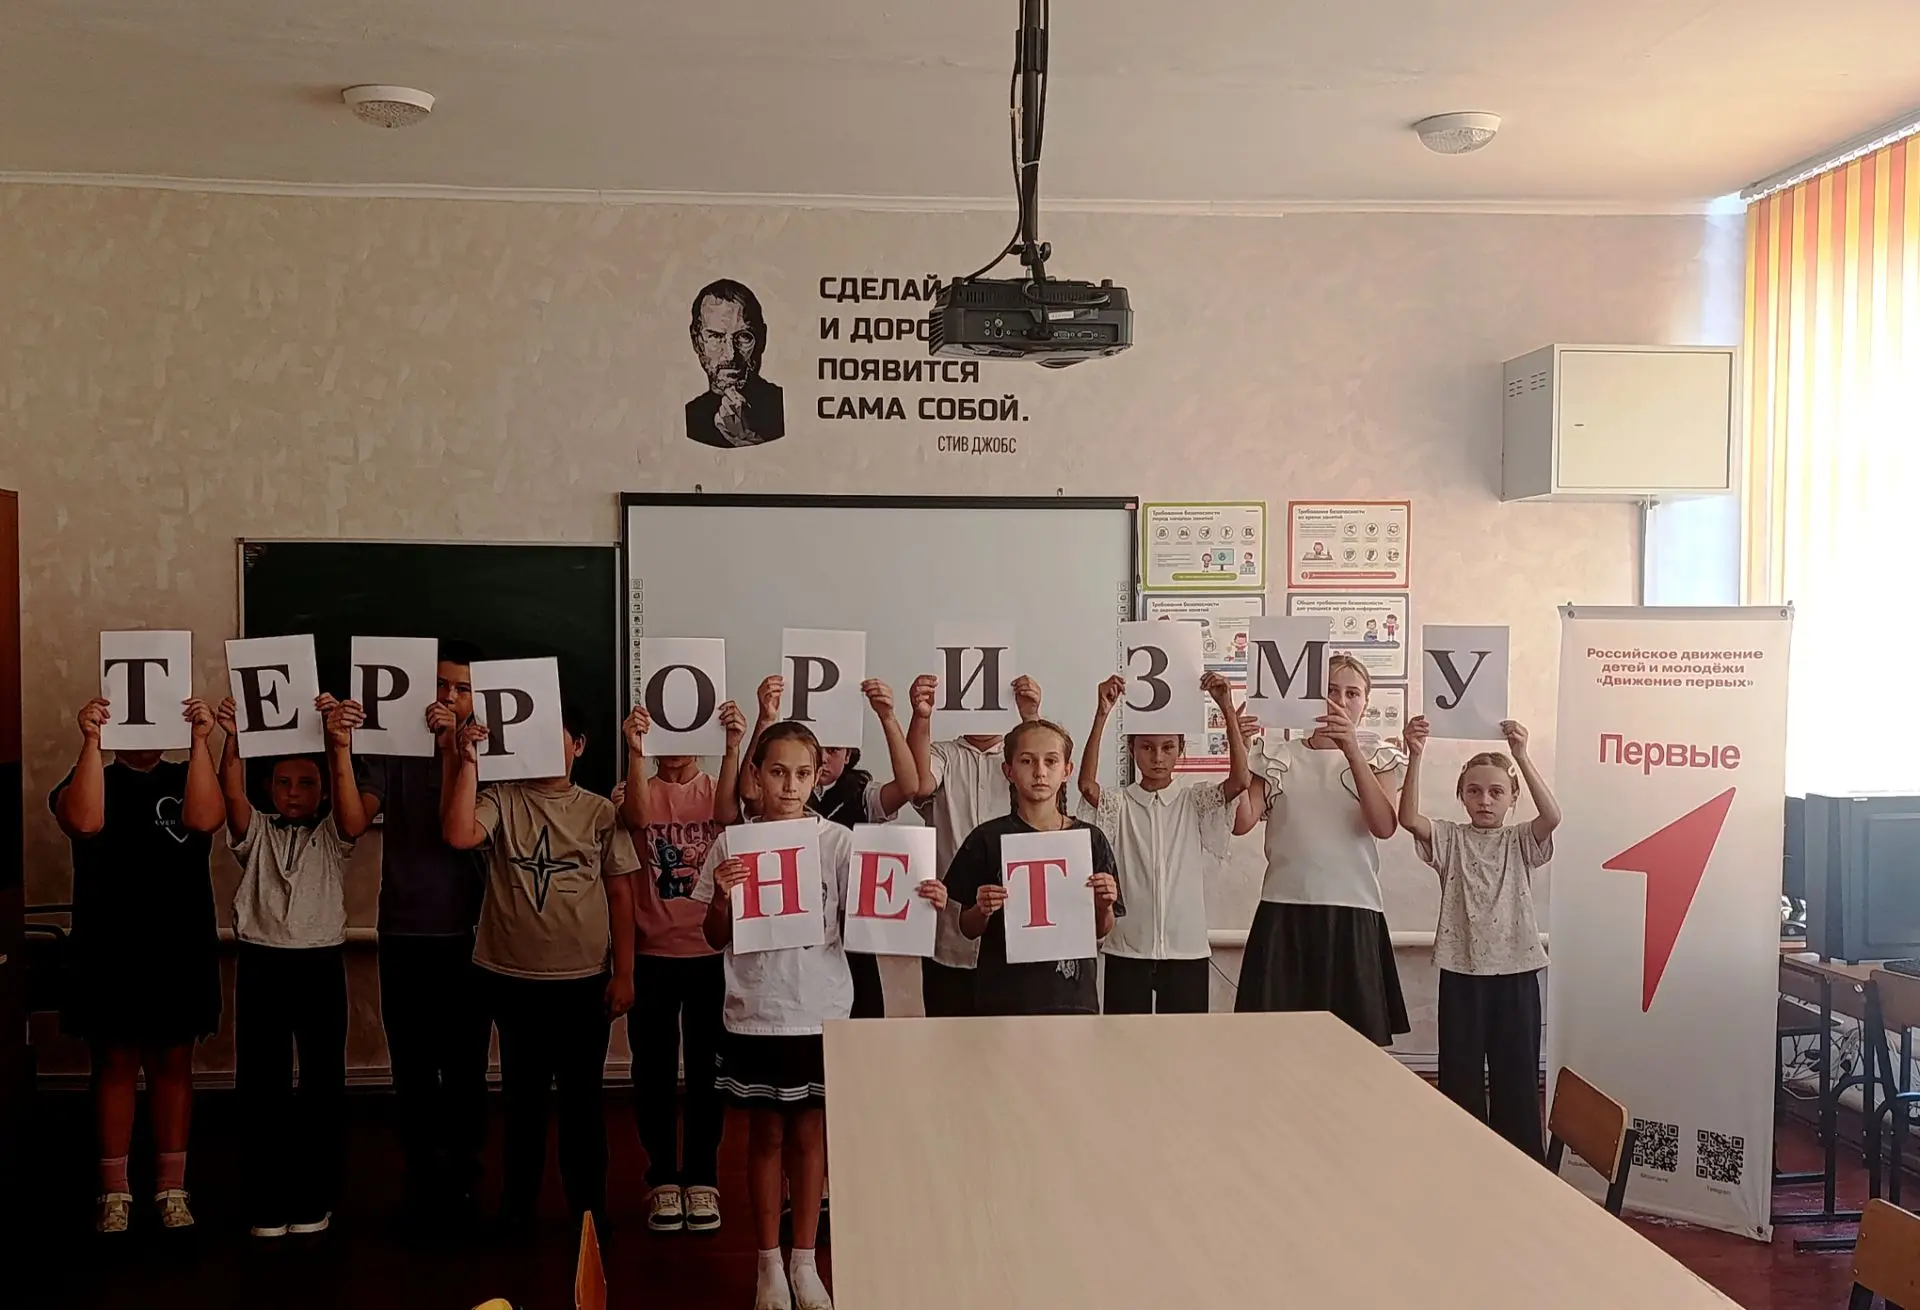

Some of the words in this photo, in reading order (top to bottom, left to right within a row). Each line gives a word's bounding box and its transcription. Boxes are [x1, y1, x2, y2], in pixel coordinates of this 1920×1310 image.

[820, 273, 942, 303] СДЕЛАЙ
[820, 318, 839, 340] И
[850, 318, 930, 343] ДОРО
[818, 358, 980, 383] ПОЯВИТСЯ
[818, 396, 906, 420] САМА
[918, 394, 1029, 421] СОБОЙ.
[937, 435, 969, 452] СТИВ
[971, 436, 1017, 455] ДЖОБС
[936, 646, 1009, 712] И
[1125, 645, 1172, 713] З
[1249, 640, 1329, 700] М
[1424, 649, 1492, 710] У
[1587, 648, 1678, 660] Российское
[1681, 650, 1764, 661] движение
[1596, 675, 1682, 687] «Движение
[1685, 678, 1754, 689] первых»
[1602, 661, 1646, 673] детей
[1649, 664, 1659, 673] и
[1661, 662, 1745, 675] молодёжи
[104, 658, 169, 726] Т
[231, 664, 299, 733] Е
[354, 664, 410, 731] Р
[644, 664, 717, 733] О
[784, 655, 840, 722] Р
[475, 688, 534, 756] Р
[1599, 733, 1741, 775] Первые
[731, 847, 809, 921] Н
[854, 851, 910, 921] Е
[1006, 858, 1068, 928] Т
